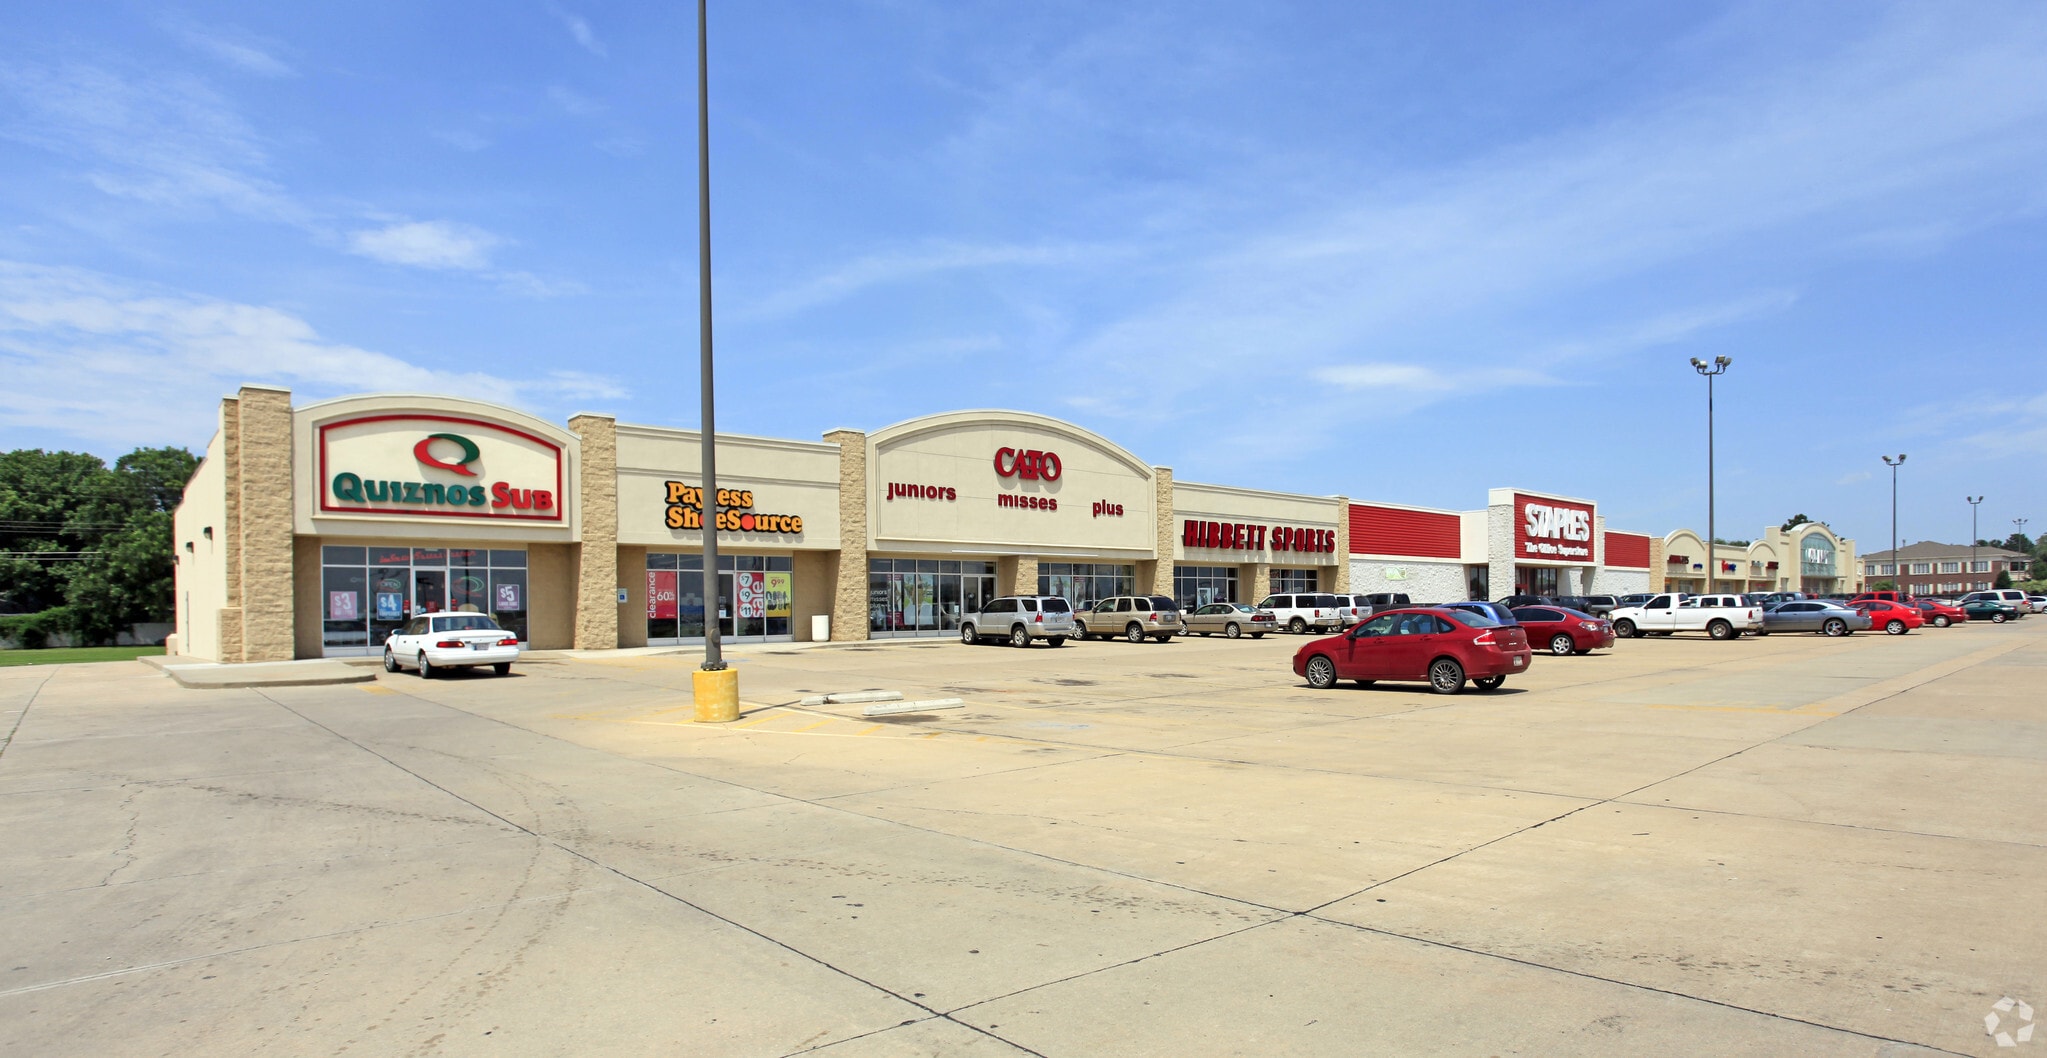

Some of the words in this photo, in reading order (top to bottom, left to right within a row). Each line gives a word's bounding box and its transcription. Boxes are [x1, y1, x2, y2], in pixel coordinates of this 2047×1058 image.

[994, 447, 1062, 481] CATO
[332, 472, 486, 506] Quiznos
[665, 481, 753, 508] Payess
[887, 482, 957, 500] juniors
[998, 493, 1058, 511] misses
[1093, 499, 1124, 517] plus
[1184, 519, 1267, 551] HIBBETT
[1272, 526, 1335, 553] SPORTS
[1524, 503, 1590, 542] STAPLES
[335, 593, 351, 609] $3
[381, 594, 397, 610] $4
[500, 586, 514, 601] $5
[647, 571, 656, 618] clearance
[753, 581, 763, 617] sale
